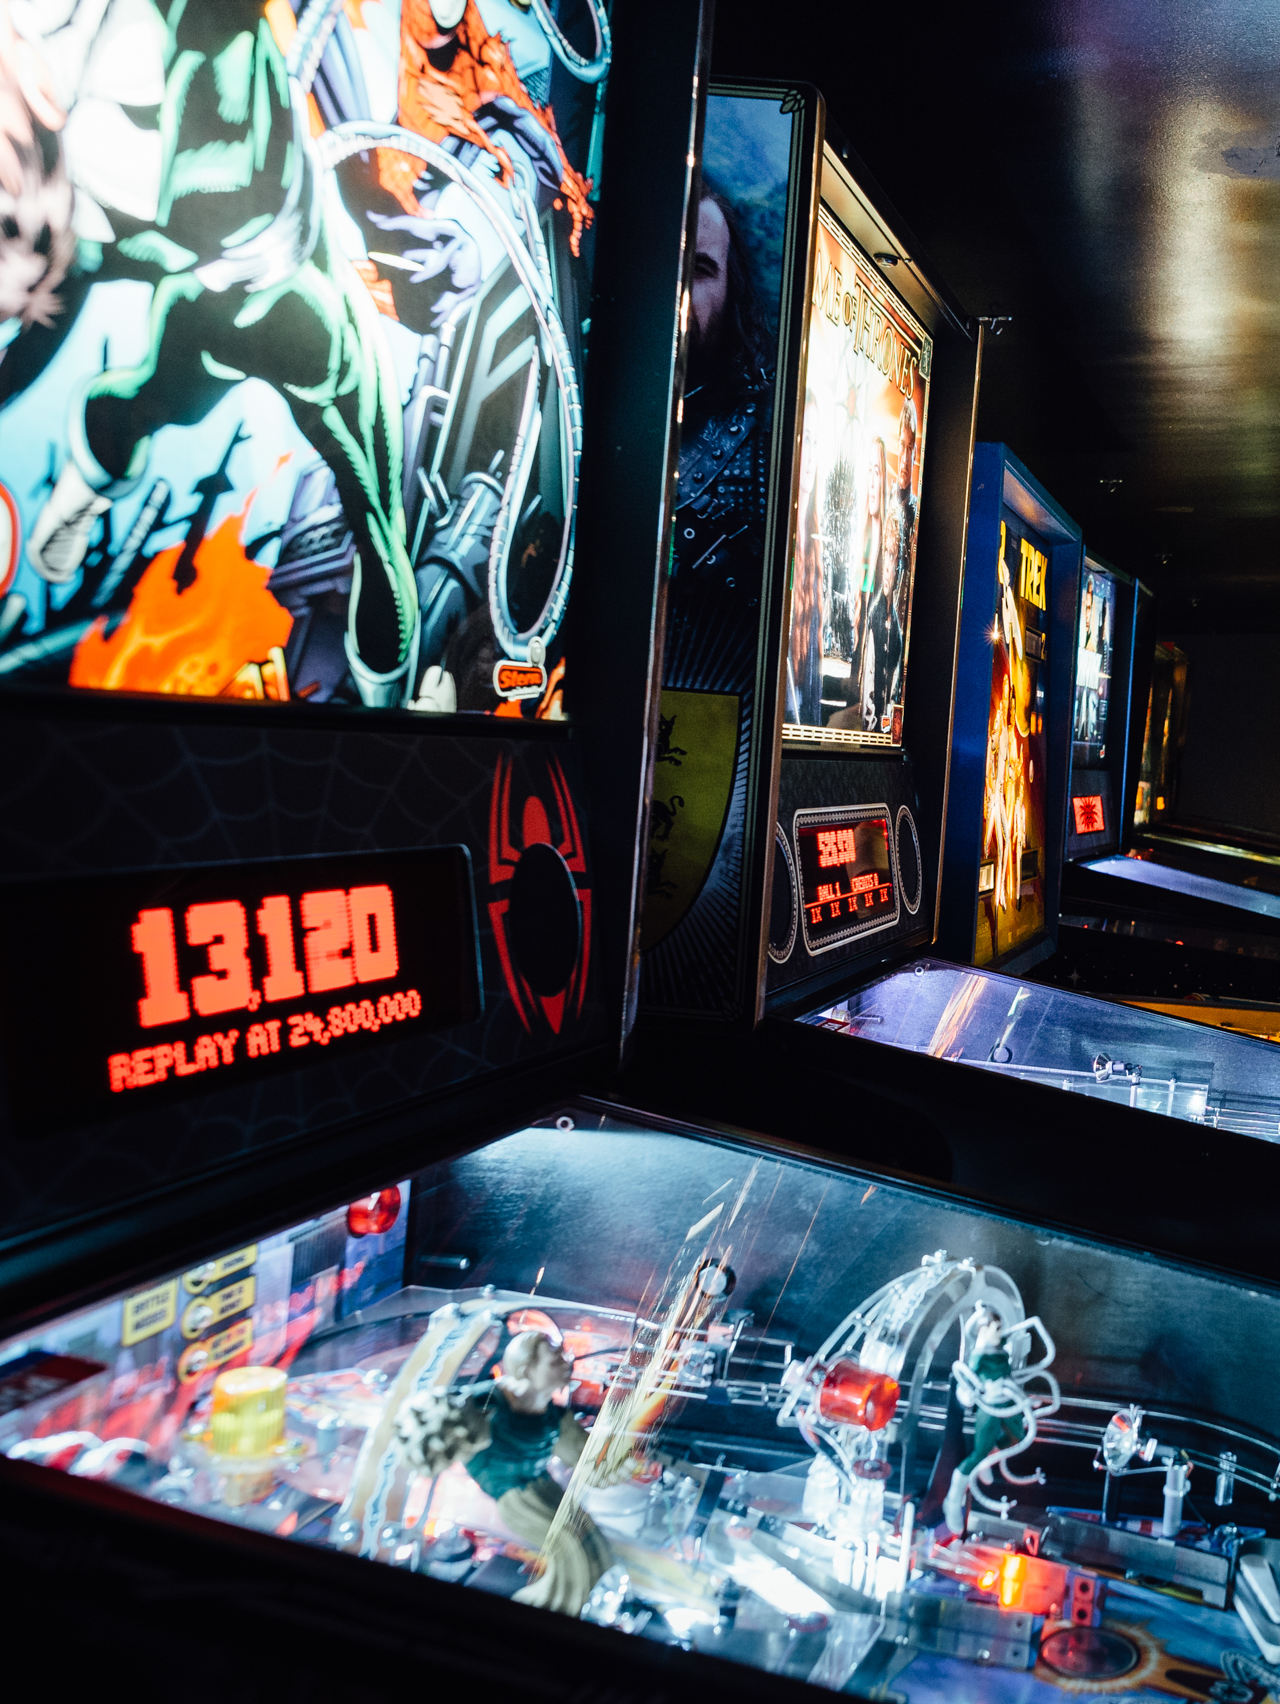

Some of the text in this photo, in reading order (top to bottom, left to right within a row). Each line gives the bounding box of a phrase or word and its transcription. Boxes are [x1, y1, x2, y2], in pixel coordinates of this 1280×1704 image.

[853, 275, 921, 400] THRONES
[1020, 537, 1048, 612] TREK
[130, 884, 399, 1029] 13,120
[108, 989, 422, 1093] REPLAY AT 24,800,000
